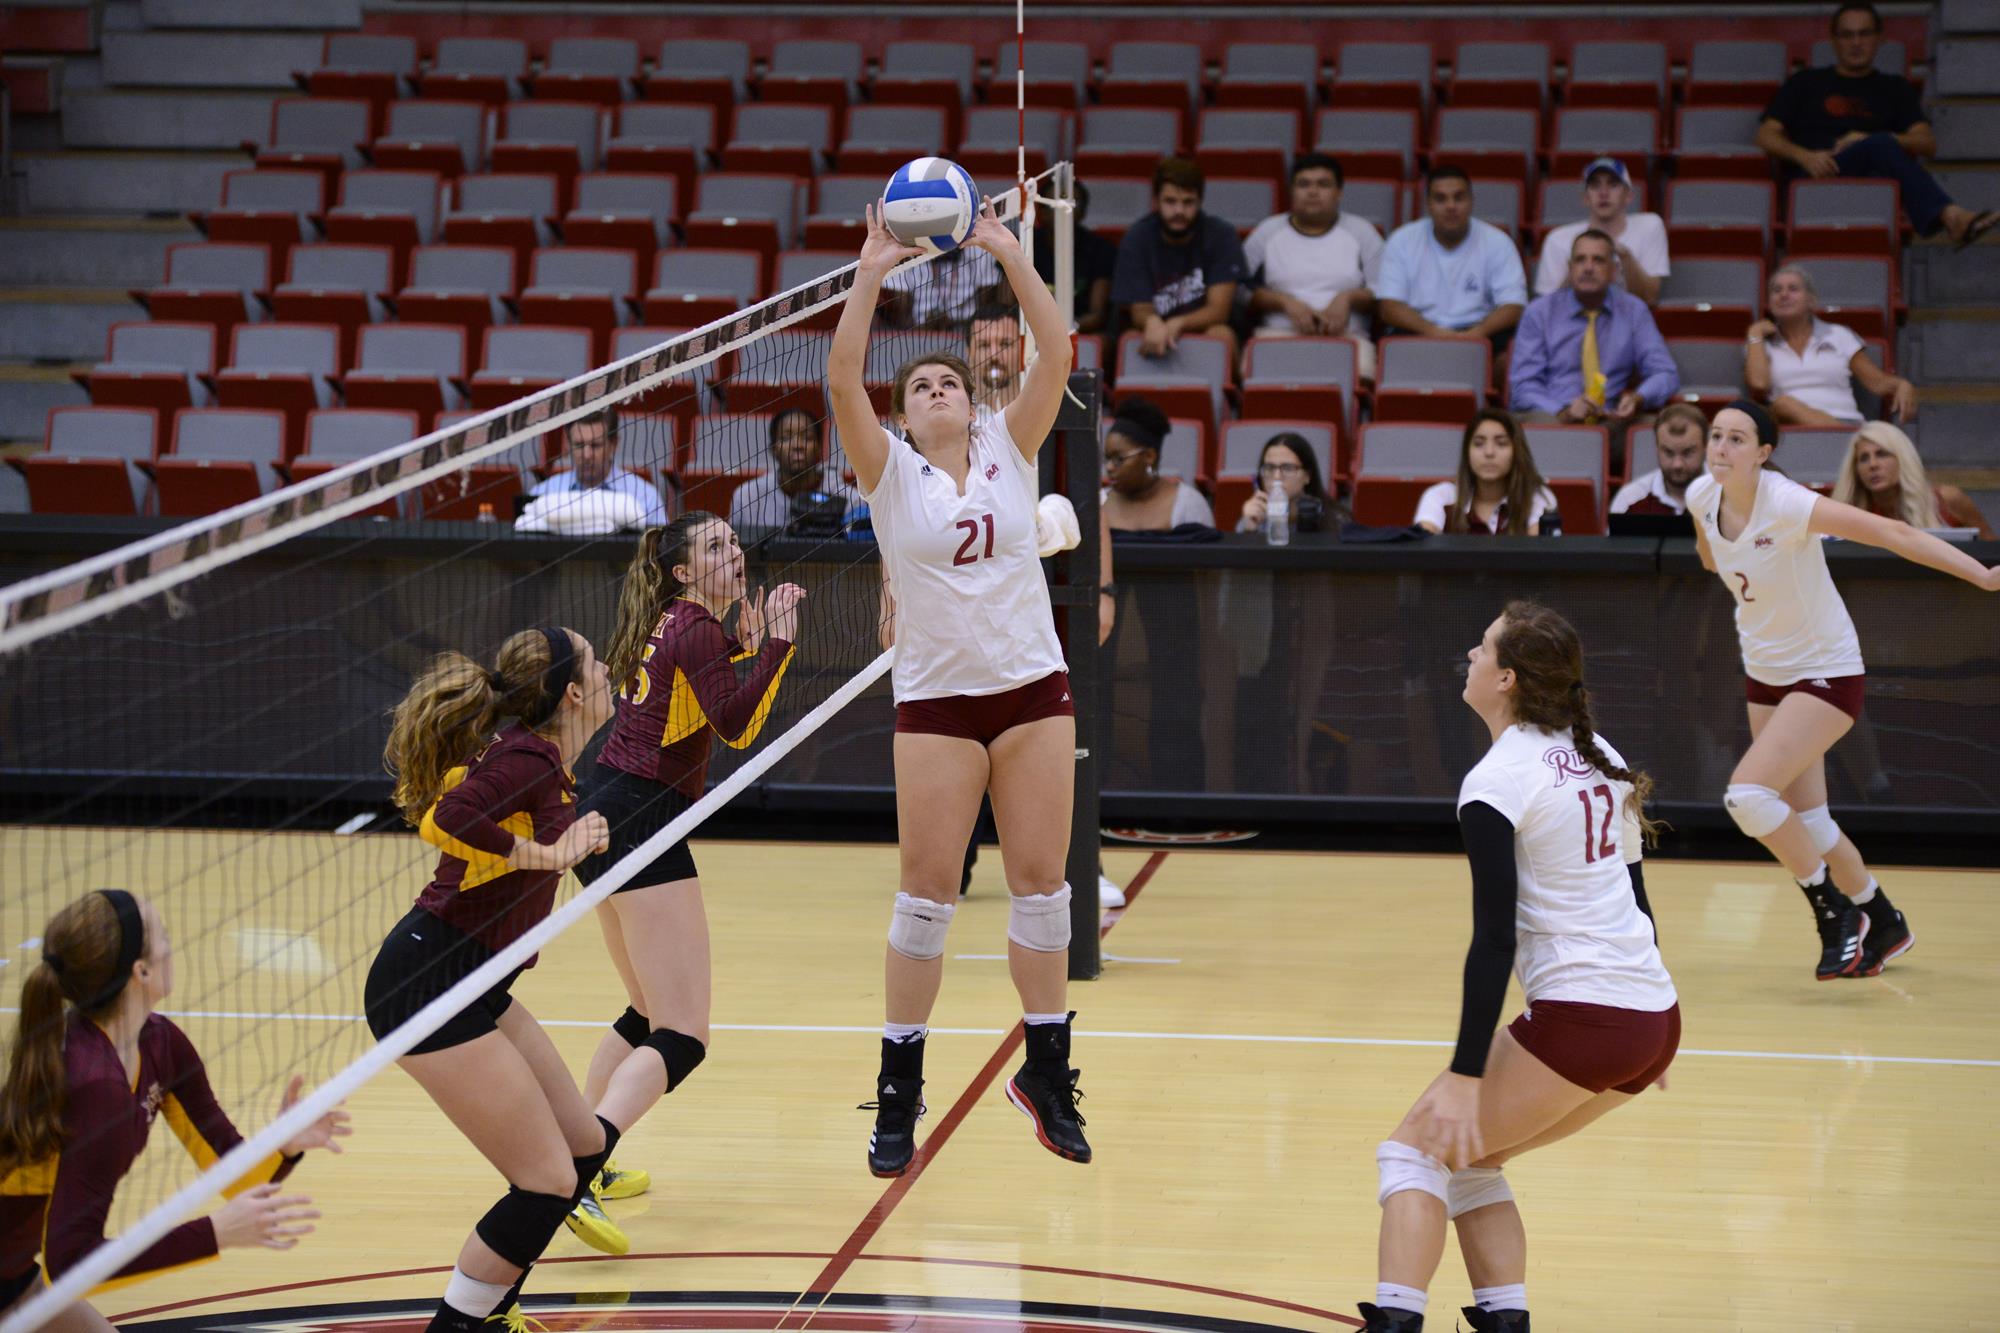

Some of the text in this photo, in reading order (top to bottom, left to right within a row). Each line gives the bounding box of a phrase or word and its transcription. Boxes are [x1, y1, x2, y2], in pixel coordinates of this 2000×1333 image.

[953, 513, 994, 567] 21
[1734, 572, 1755, 602] 2
[620, 643, 656, 705] 5
[1578, 783, 1616, 864] 12
